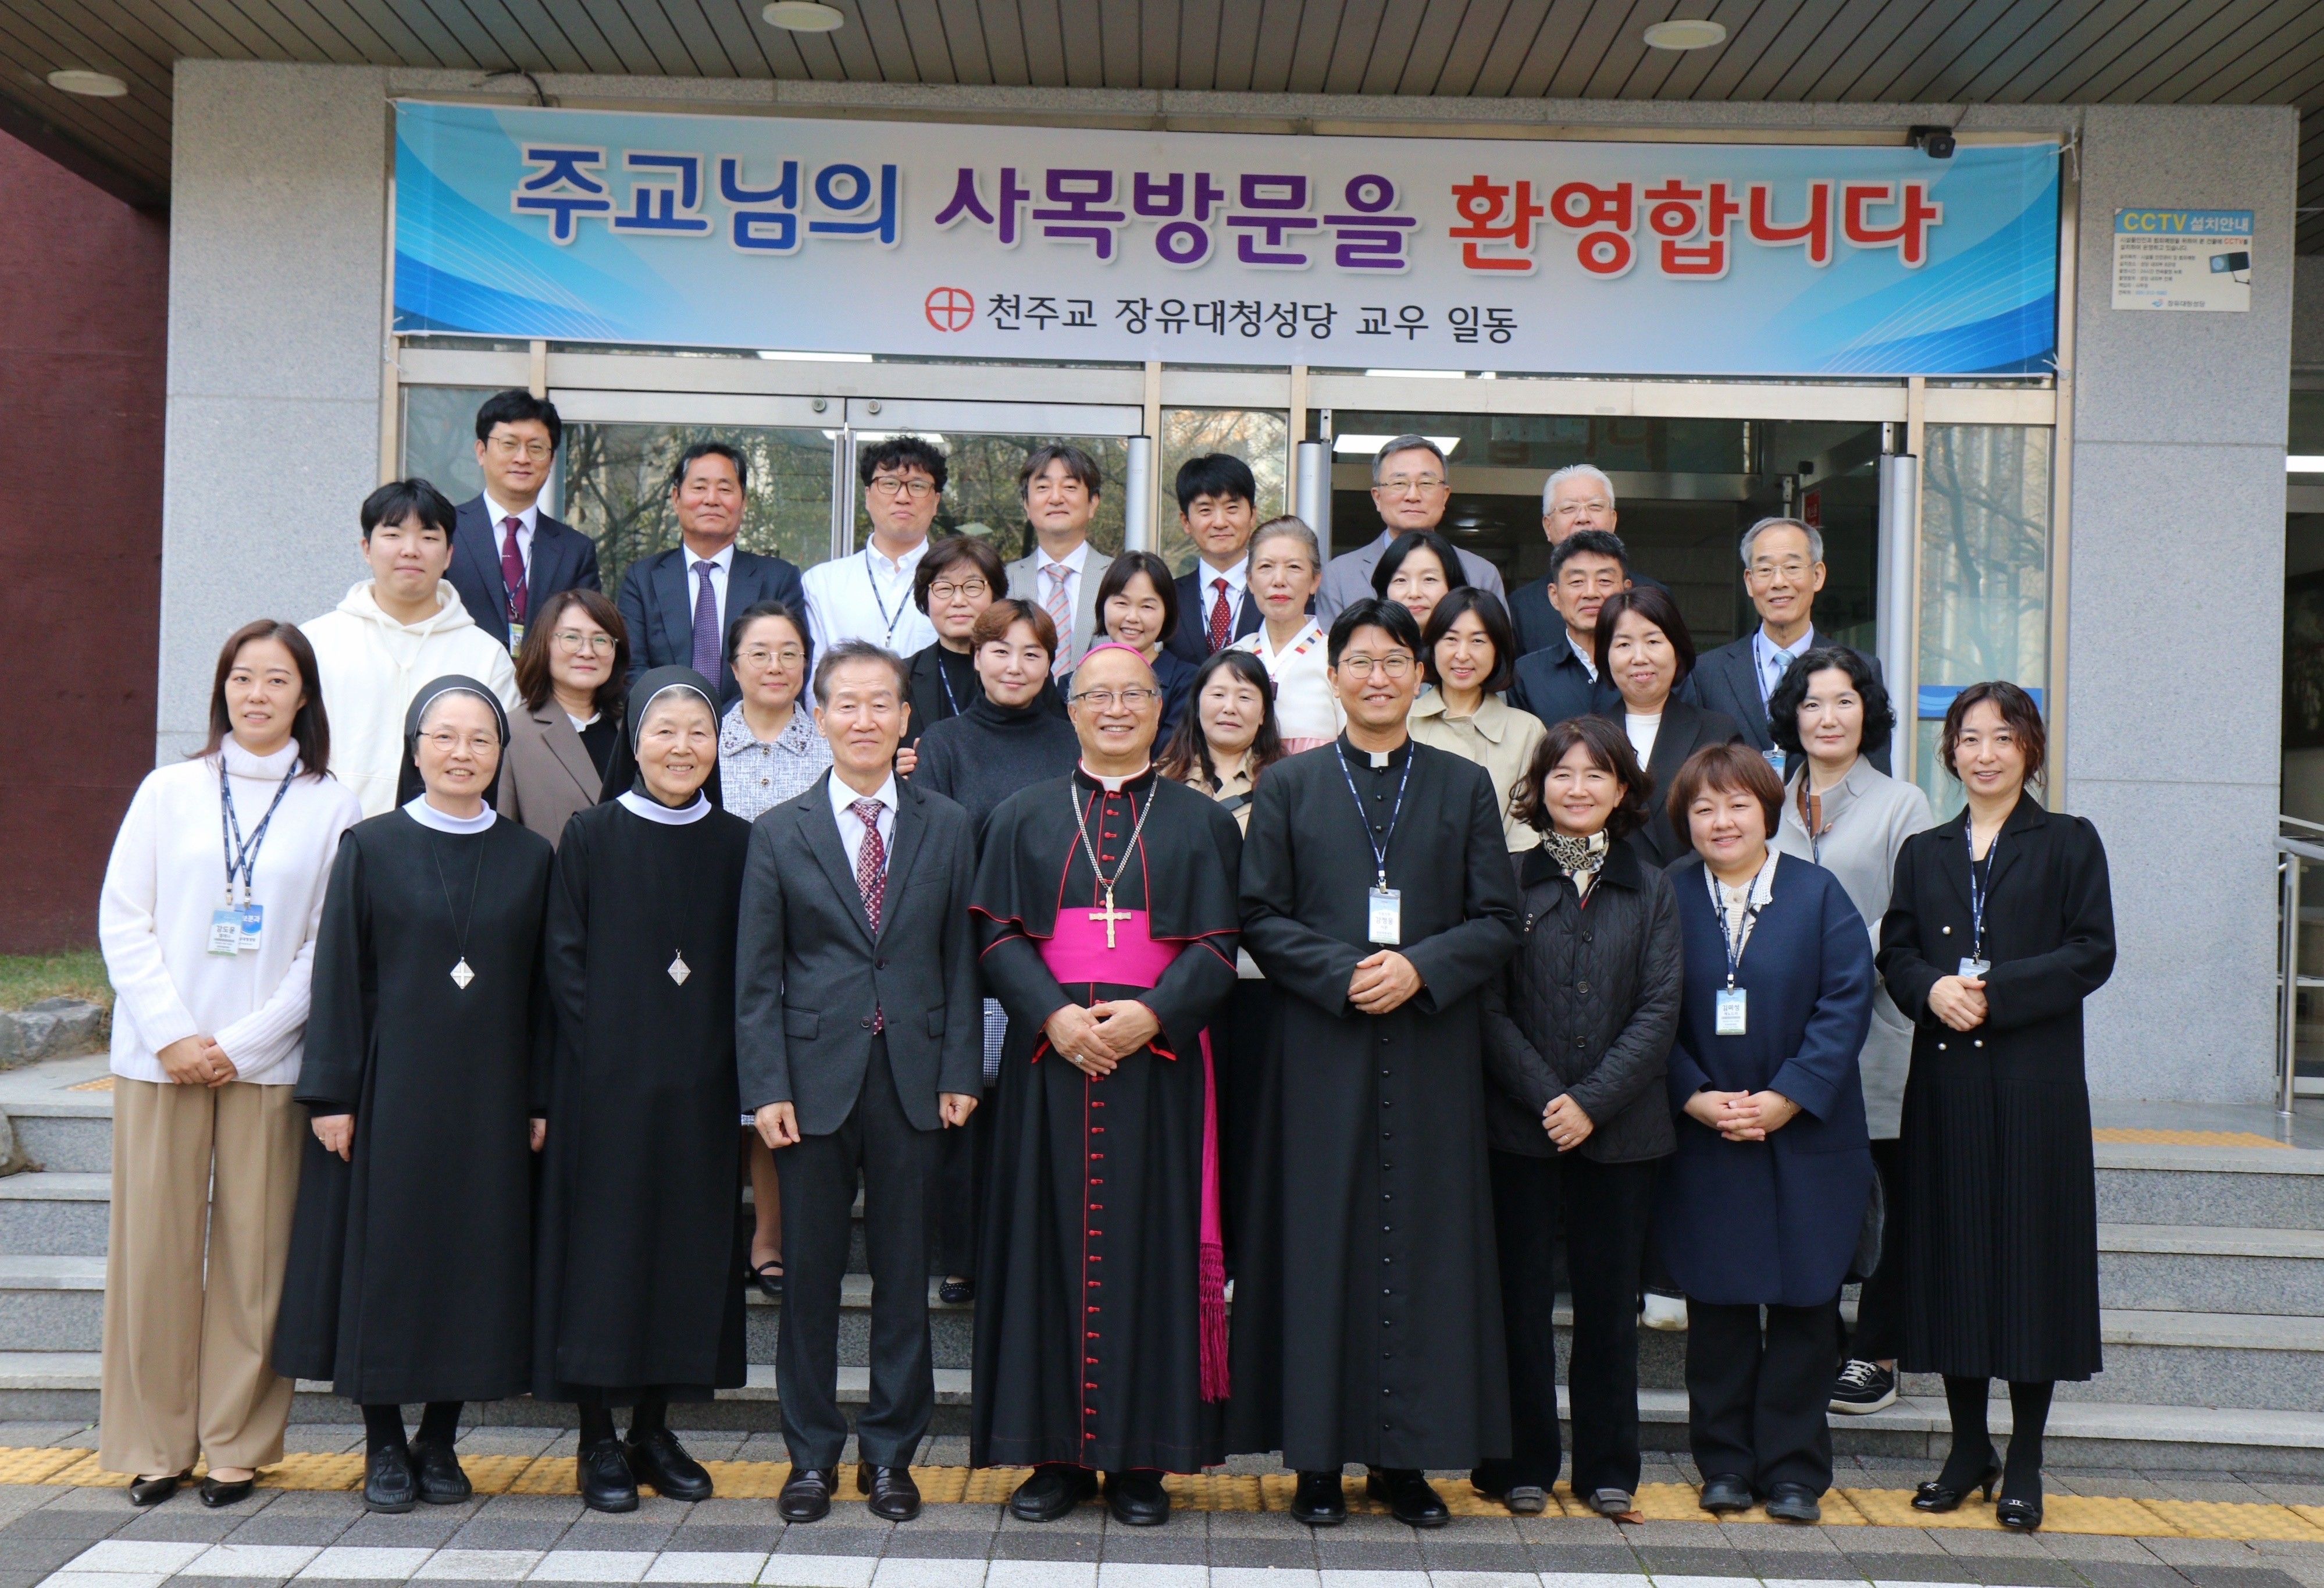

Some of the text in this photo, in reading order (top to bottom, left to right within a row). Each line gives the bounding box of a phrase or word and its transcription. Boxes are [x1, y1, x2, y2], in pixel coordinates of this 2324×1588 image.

[517, 149, 1938, 276] 주교님의 사목방문을 환영합니다
[2124, 212, 2248, 232] CCTV 설치안내
[987, 293, 1517, 344] 천주교 장유대청성당 교우 일동
